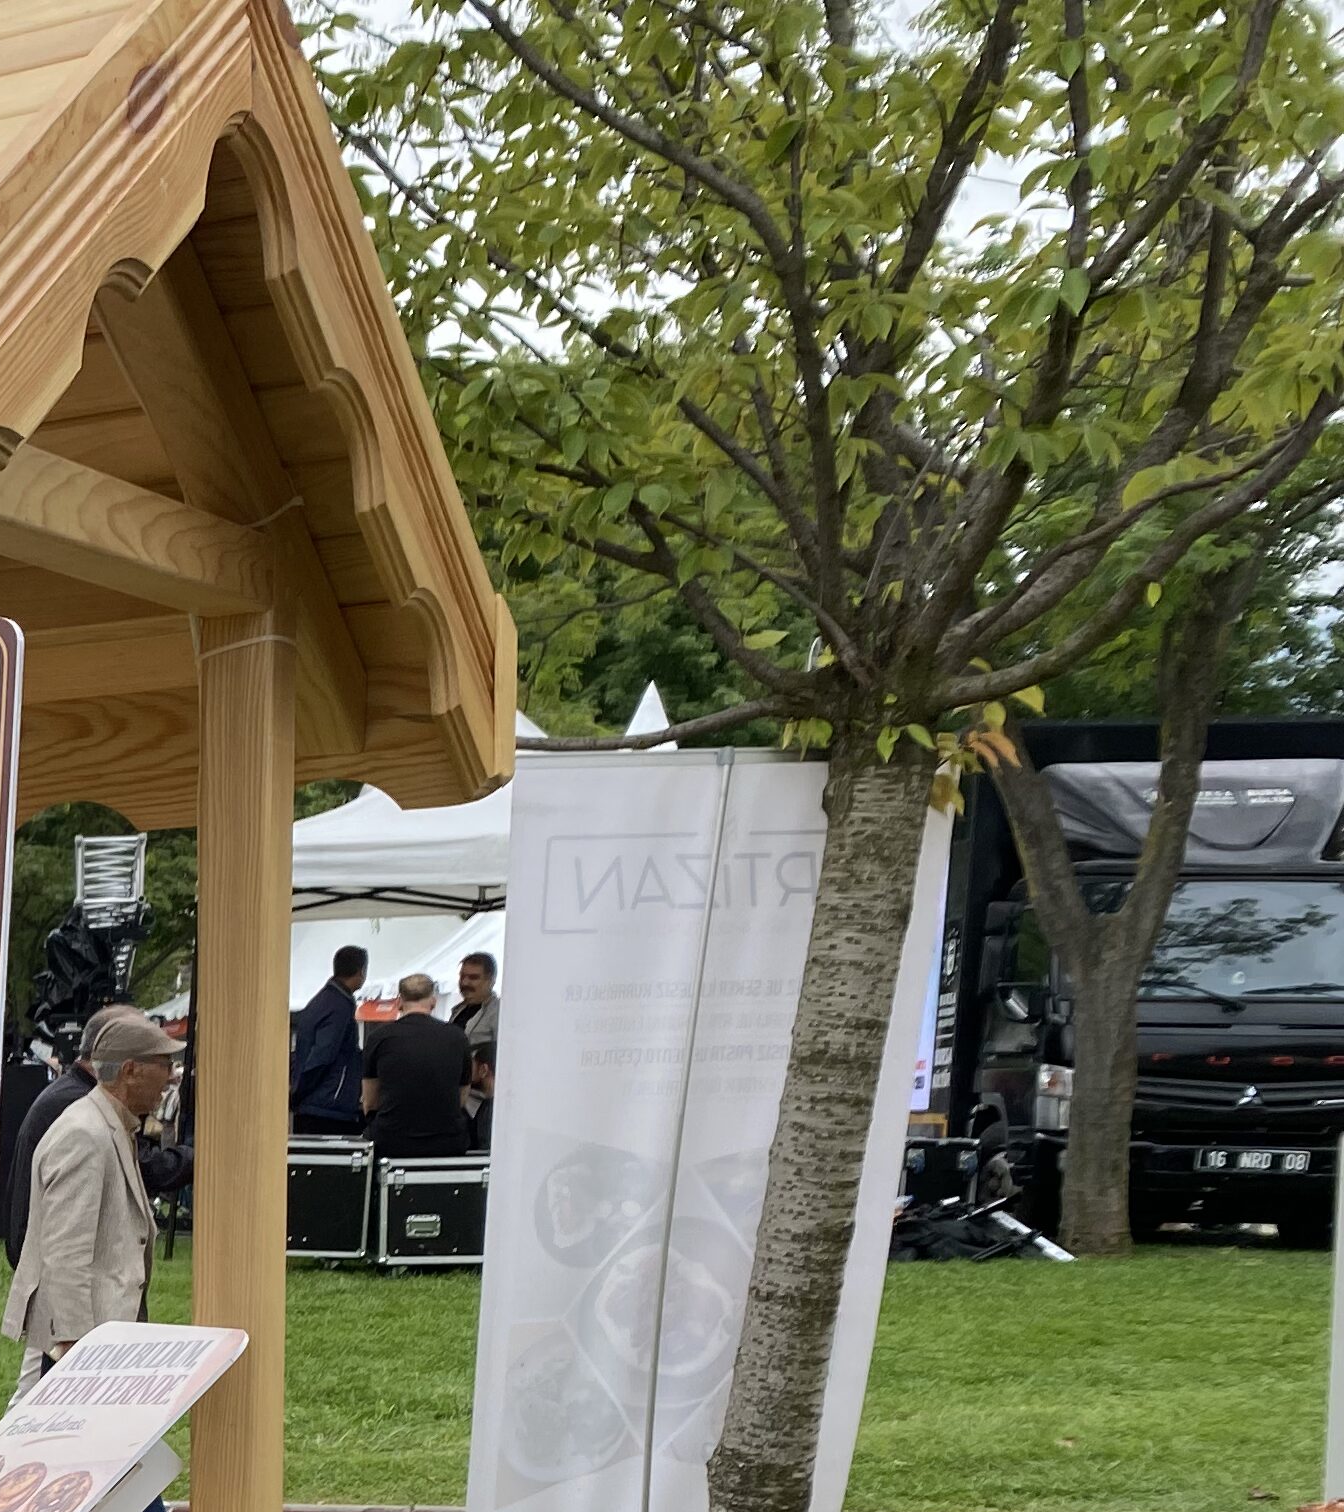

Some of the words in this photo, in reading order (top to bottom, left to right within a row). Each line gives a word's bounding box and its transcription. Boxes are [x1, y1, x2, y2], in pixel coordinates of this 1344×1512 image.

[1208, 1150, 1228, 1167] 16
[1239, 1152, 1273, 1169] NRD
[1284, 1153, 1306, 1171] 08
